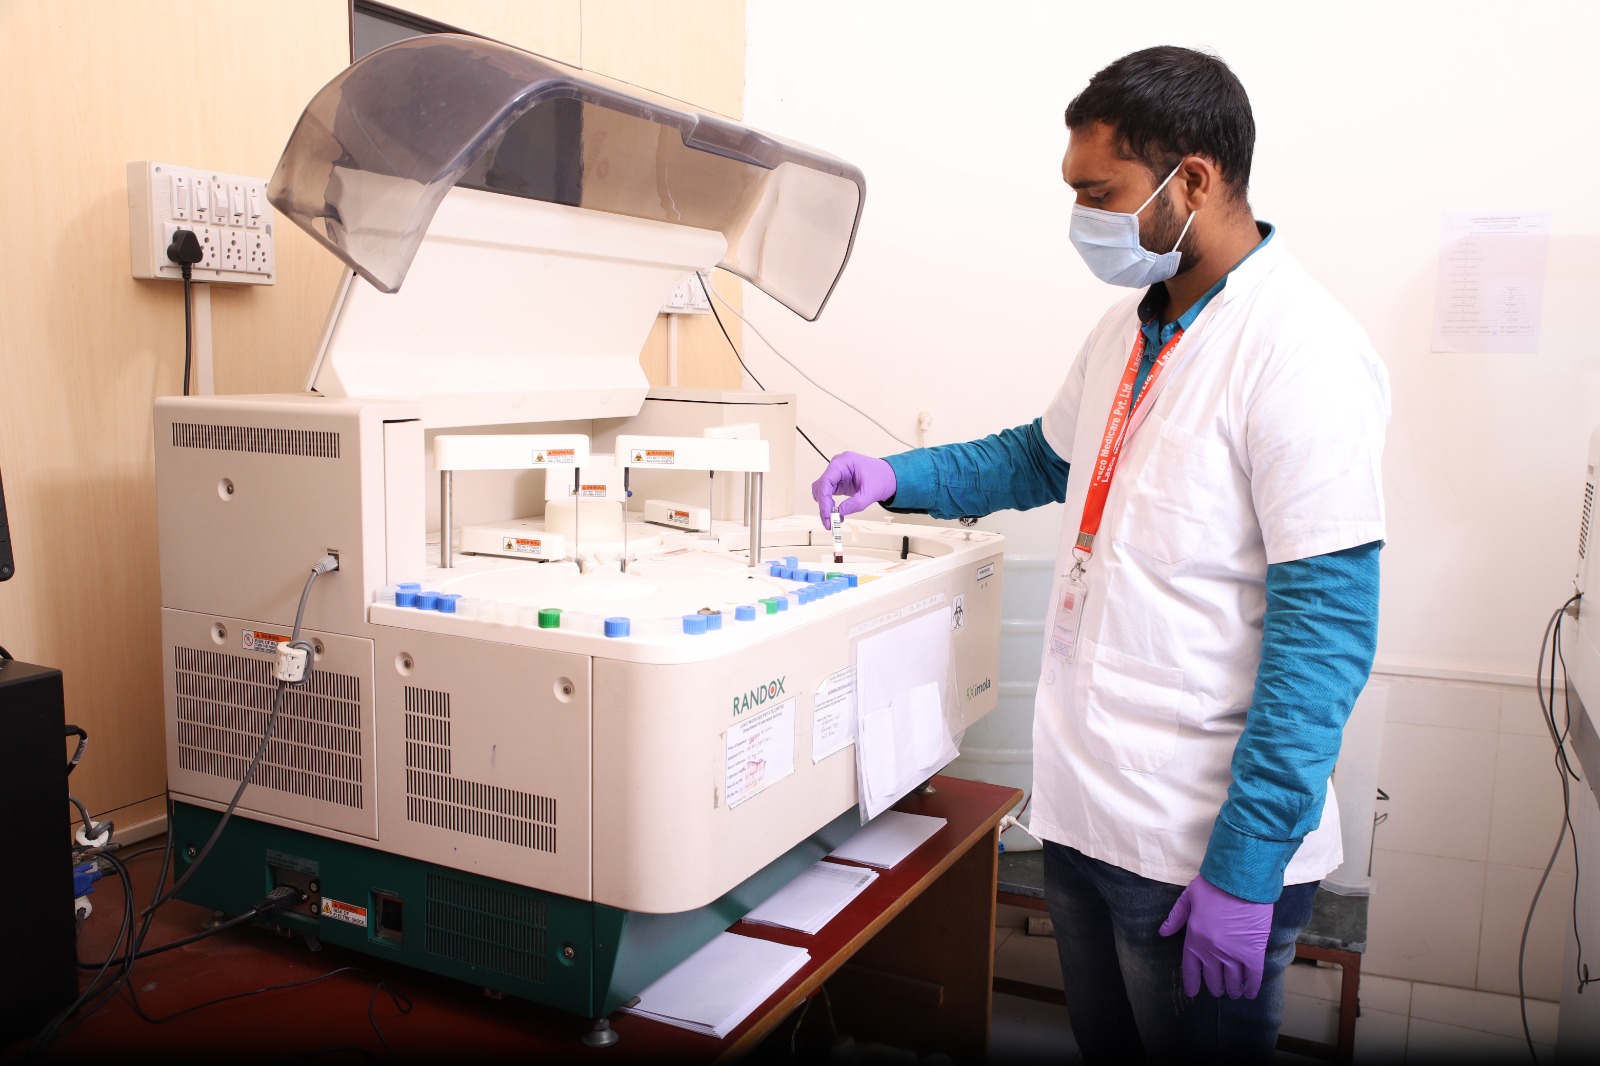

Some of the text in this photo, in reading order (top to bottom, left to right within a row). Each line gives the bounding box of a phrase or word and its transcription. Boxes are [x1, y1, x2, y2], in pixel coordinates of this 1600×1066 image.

[1129, 347, 1145, 373] Lasco
[1119, 383, 1134, 398] Ltd.
[1113, 399, 1128, 416] Pvt.
[1100, 417, 1121, 457] Medicare
[733, 675, 786, 717] RANDOX
